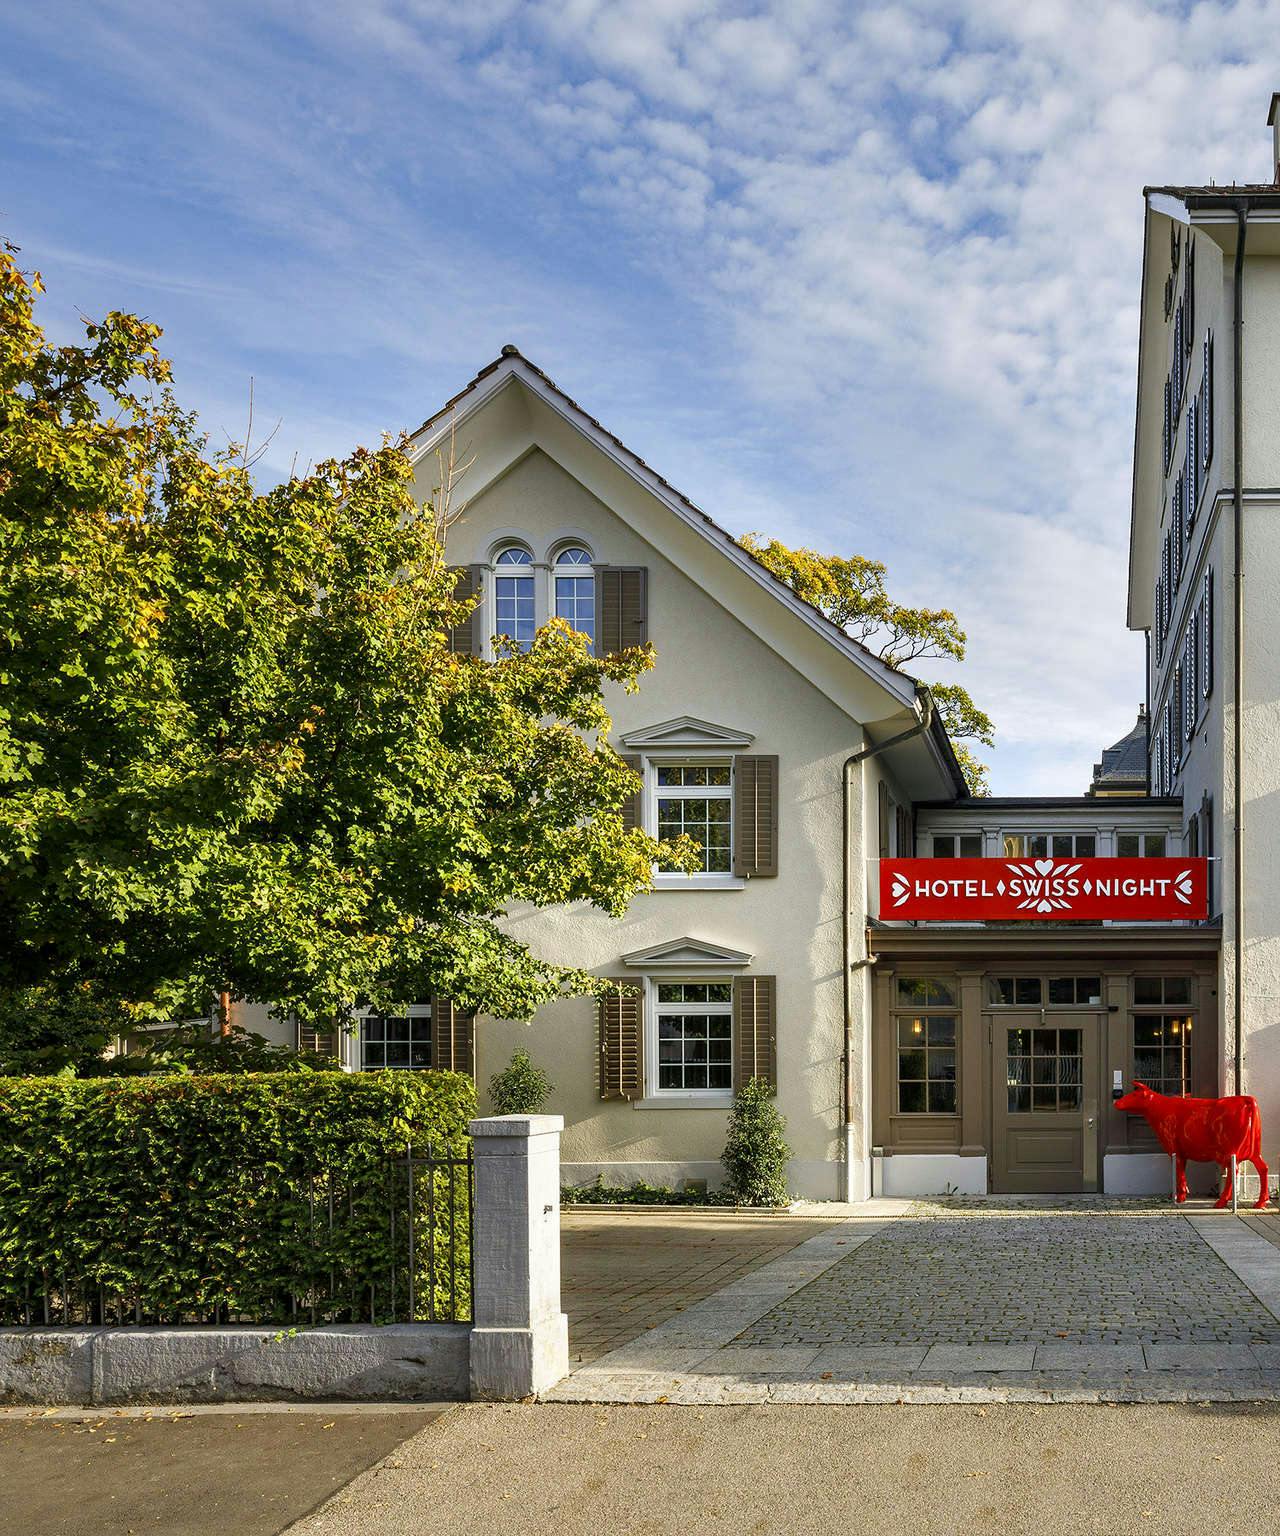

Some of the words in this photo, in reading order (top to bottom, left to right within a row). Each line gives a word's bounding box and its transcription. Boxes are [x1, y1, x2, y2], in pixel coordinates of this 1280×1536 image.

[915, 879, 994, 898] HOTEL
[1008, 878, 1080, 898] SWISS
[1096, 878, 1172, 897] NIGHT
